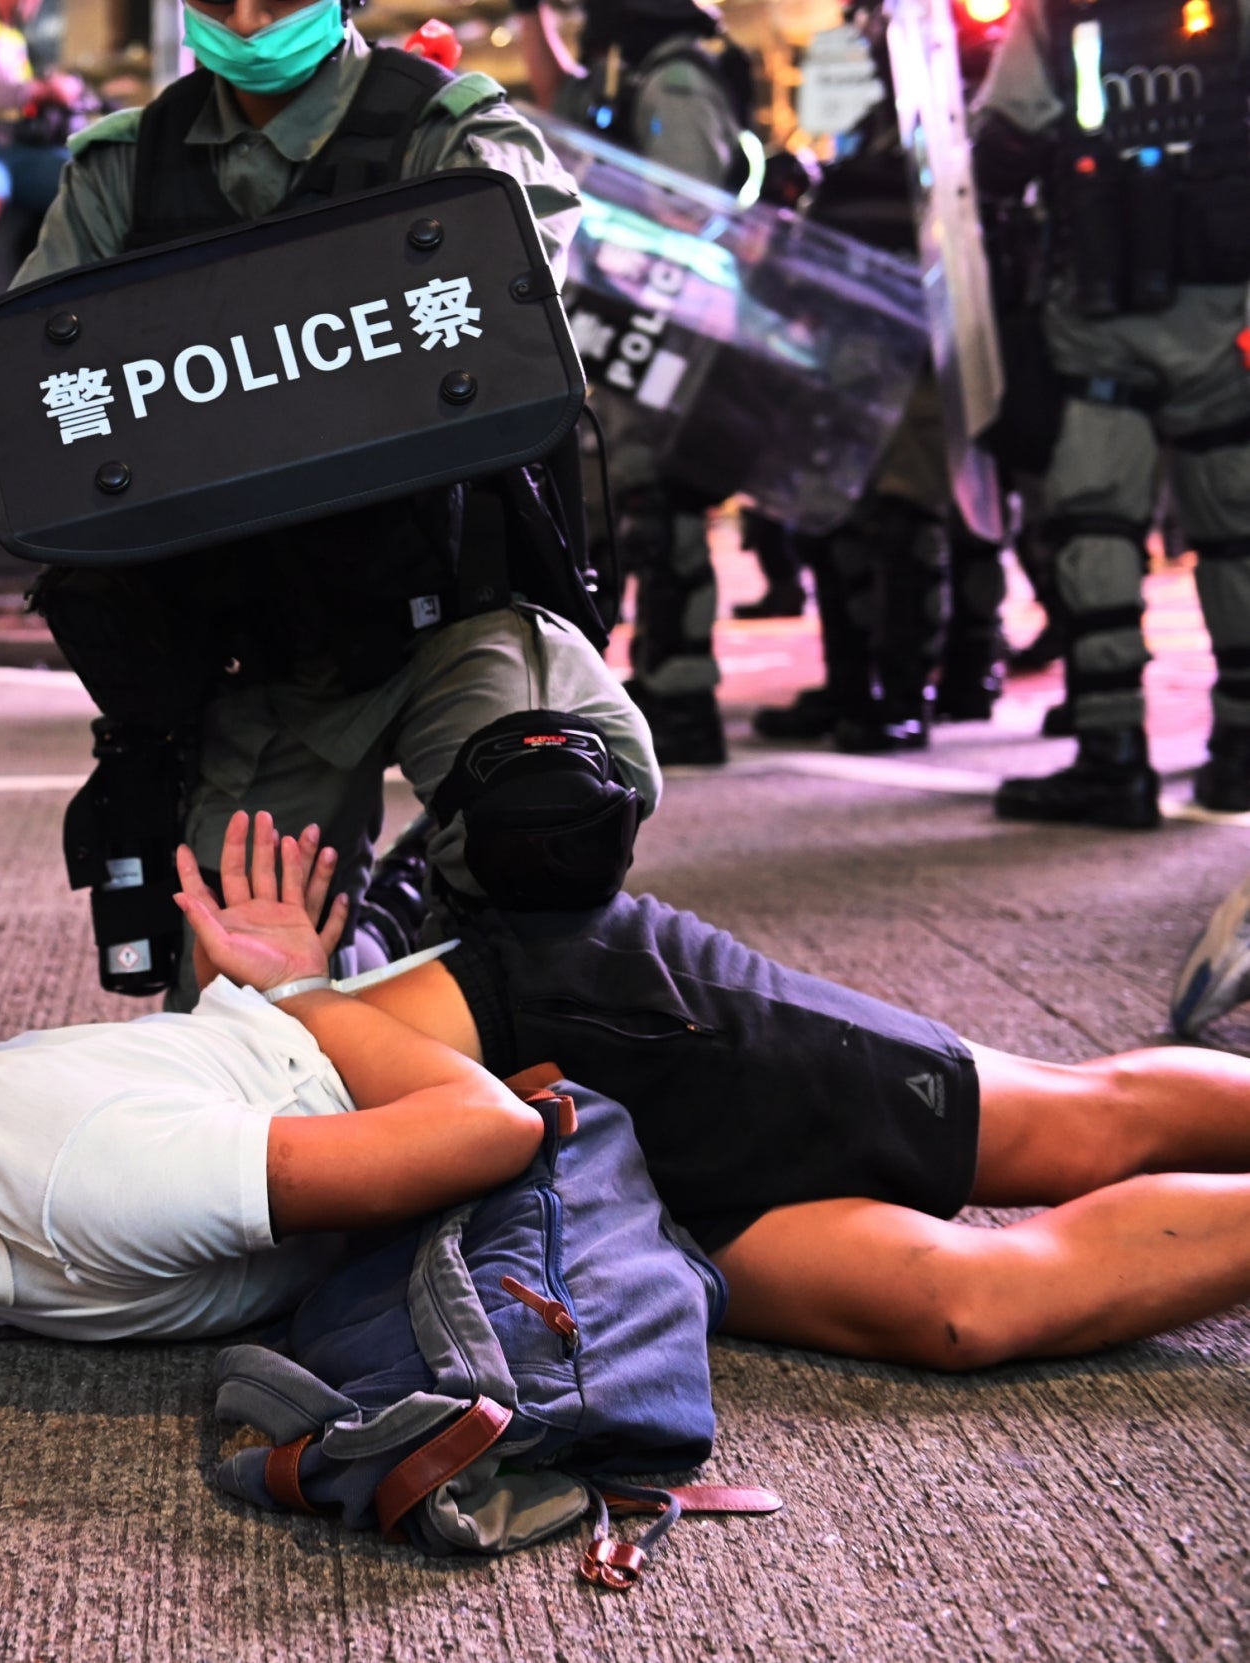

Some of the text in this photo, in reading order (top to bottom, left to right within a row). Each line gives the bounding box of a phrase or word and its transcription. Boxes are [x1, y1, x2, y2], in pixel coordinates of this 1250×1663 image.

[39, 367, 115, 446] 警
[122, 298, 402, 419] POLICE
[403, 276, 483, 351] 察
